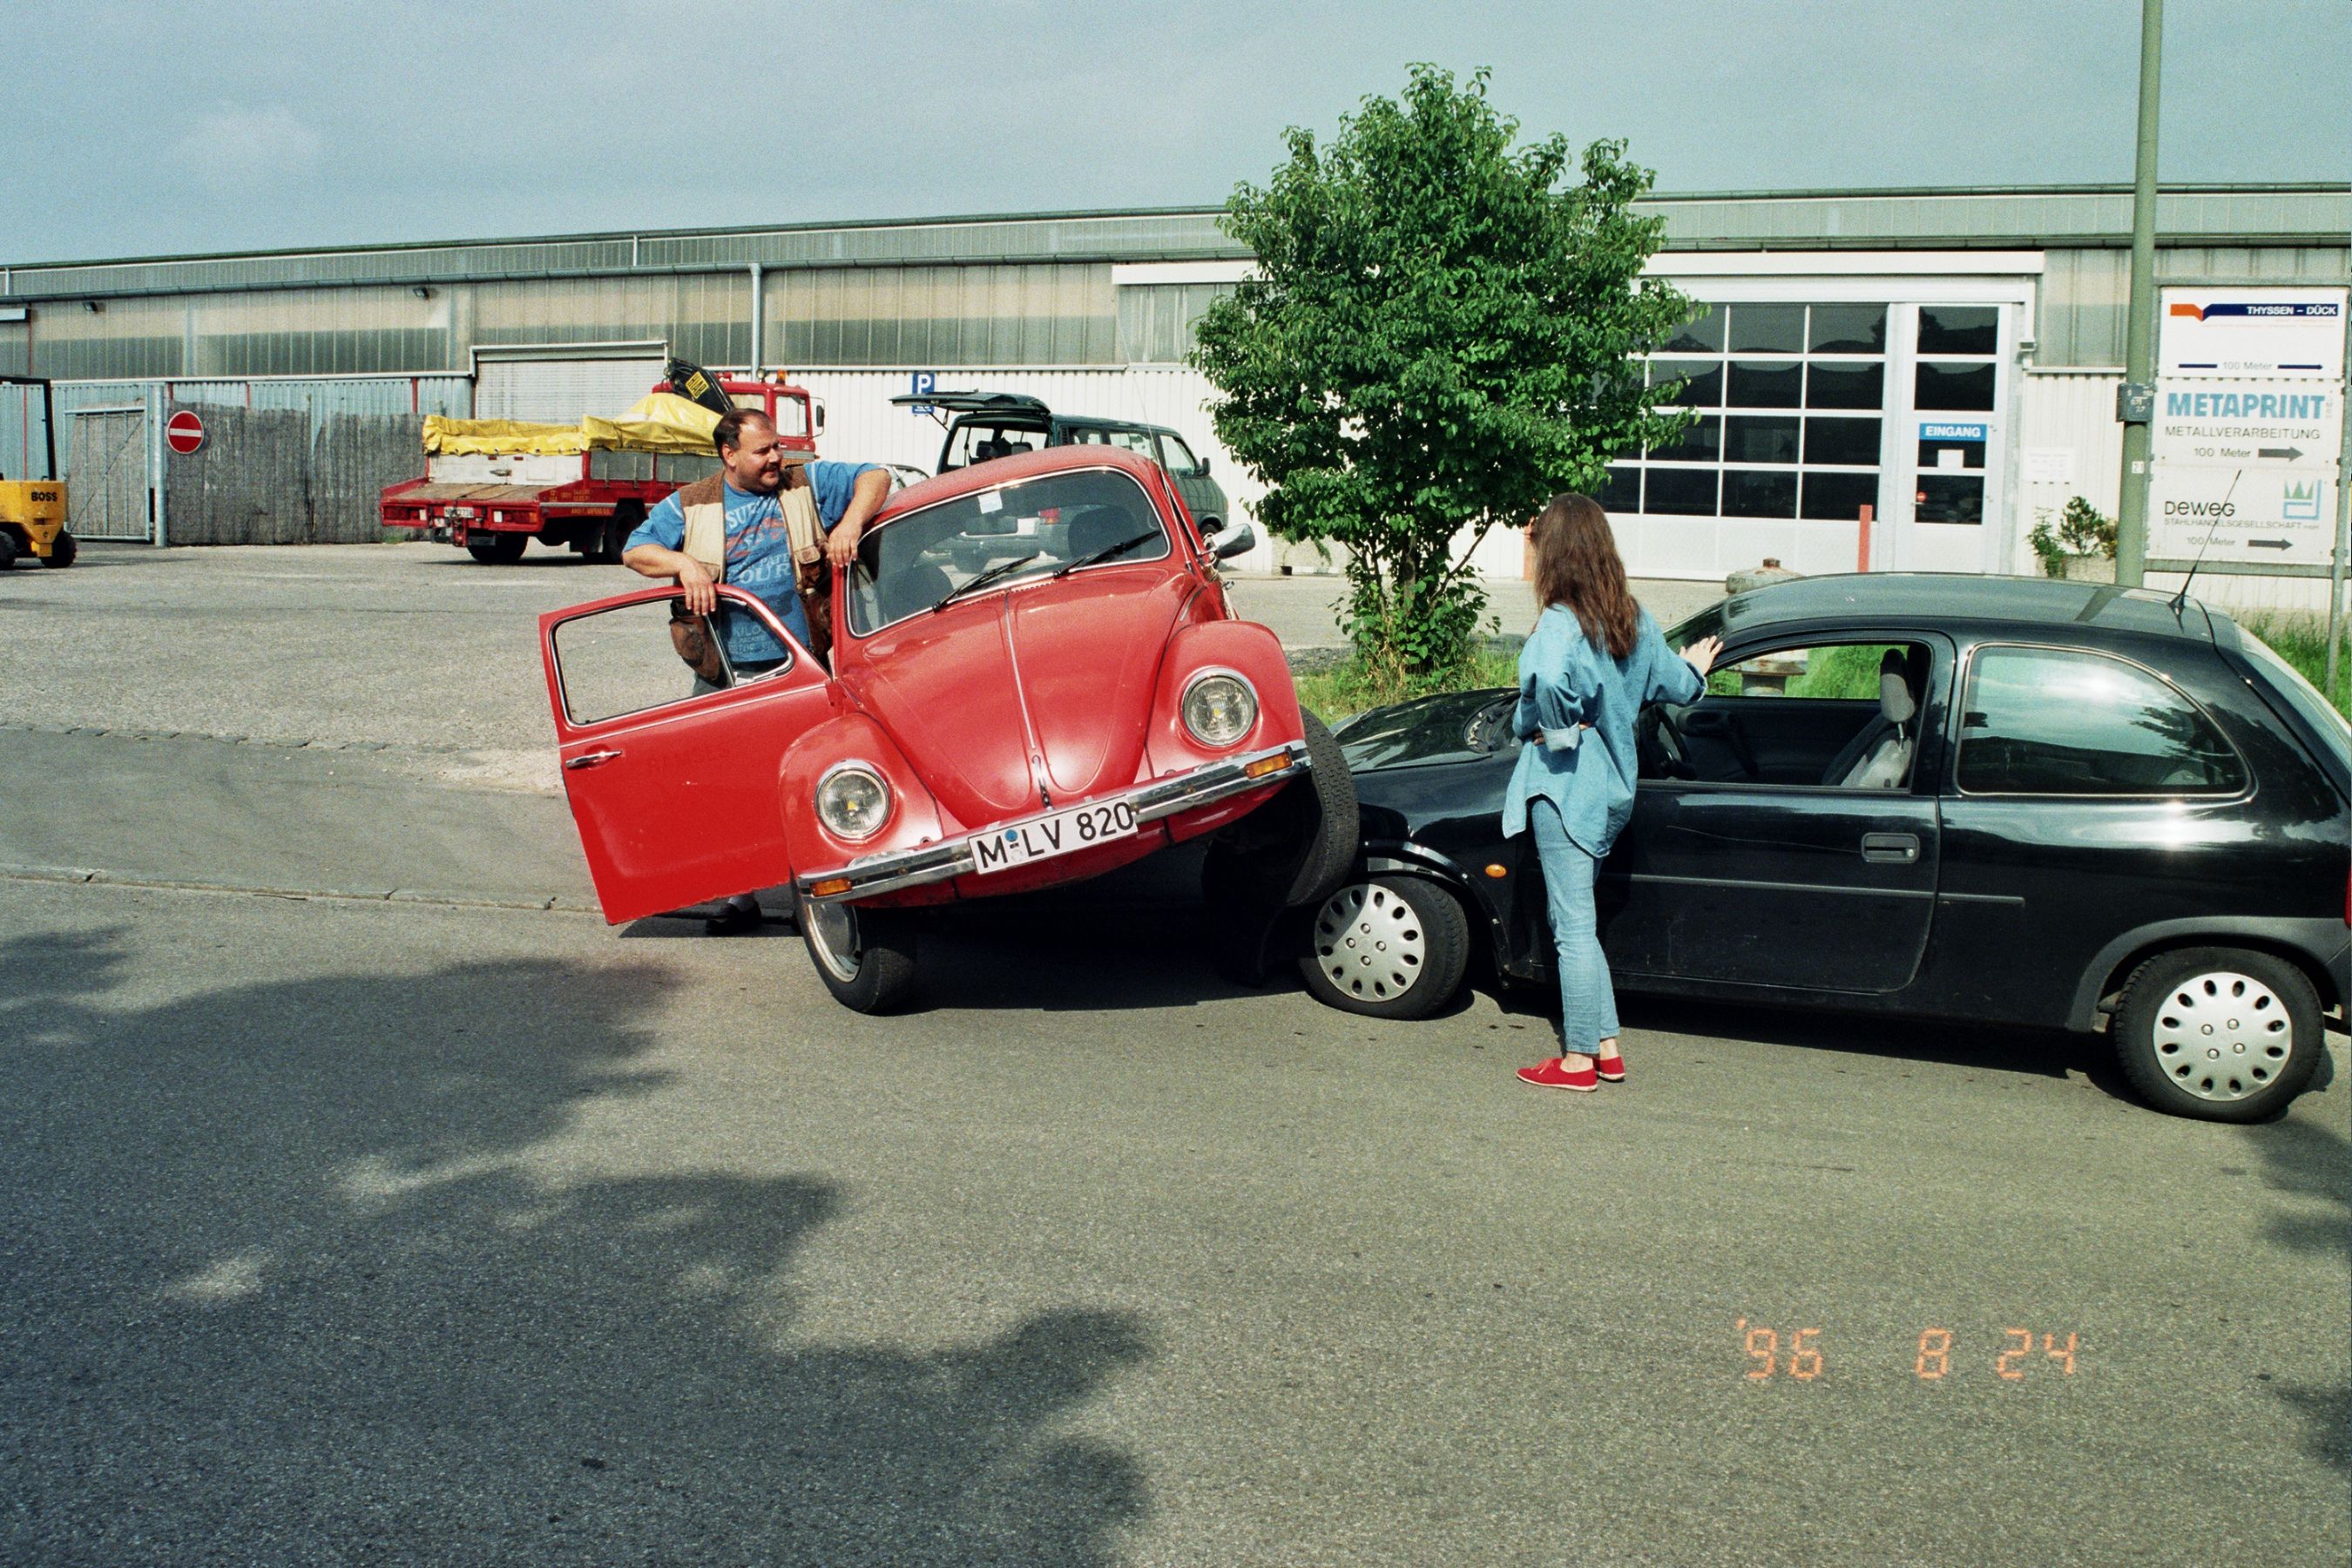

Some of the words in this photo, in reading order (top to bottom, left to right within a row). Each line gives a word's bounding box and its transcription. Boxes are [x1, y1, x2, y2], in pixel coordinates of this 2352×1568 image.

[2247, 306, 2295, 314] THYSSEN
[2306, 305, 2336, 314] DÜCK
[2223, 362, 2240, 370] 100
[2243, 362, 2273, 370] Meter
[917, 374, 931, 395] P
[2166, 393, 2326, 419] METAPRINT
[1925, 426, 1981, 437] EINGANG
[2165, 426, 2321, 440] METALLVERARBEITUNG
[2194, 447, 2214, 457] 100
[2220, 447, 2251, 458] Meter
[31, 491, 57, 502] BOSS
[2164, 517, 2301, 530] STAHLHANDELSGESELLSCHAFT
[2186, 537, 2204, 545] 100
[2209, 537, 2236, 546] Meter
[977, 819, 1060, 868] M-LV
[1077, 801, 1134, 841] 820
